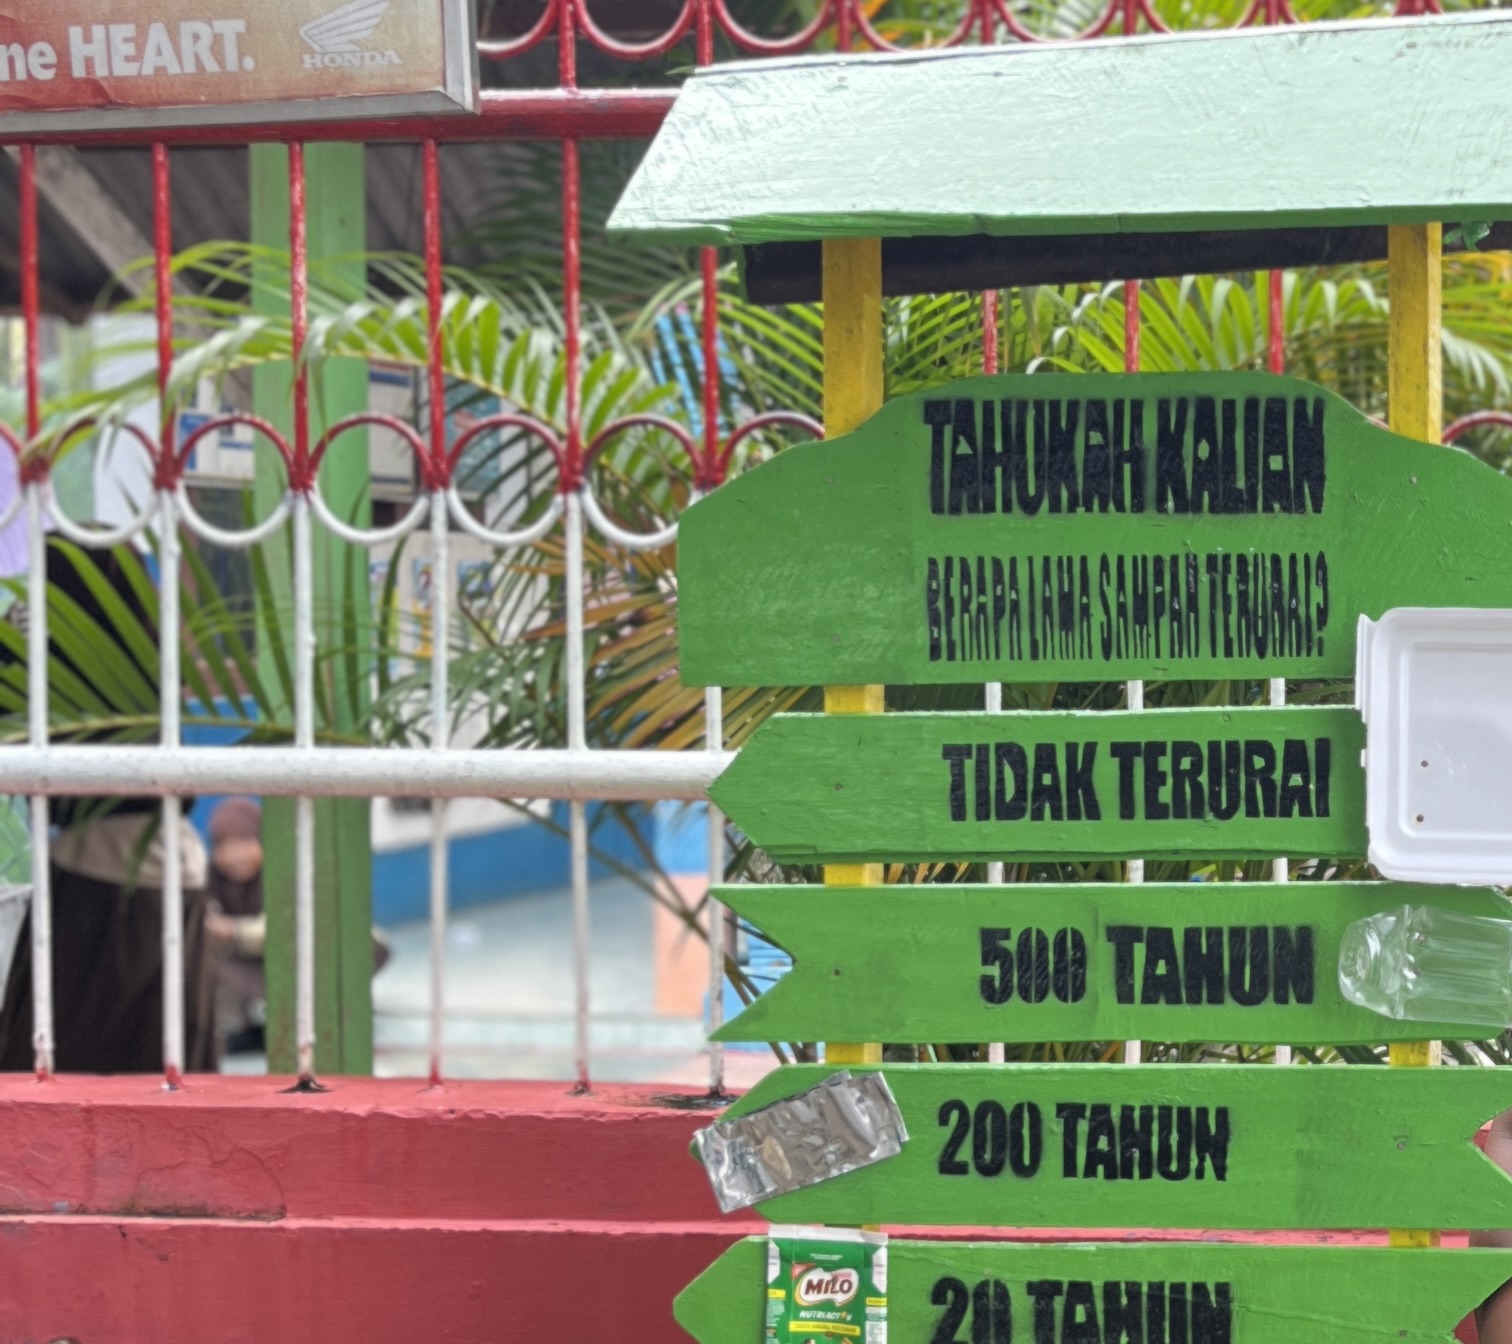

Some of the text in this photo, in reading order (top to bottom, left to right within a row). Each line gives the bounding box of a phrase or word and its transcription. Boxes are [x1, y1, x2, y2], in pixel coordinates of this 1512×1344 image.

[68, 18, 256, 79] HEART.
[302, 50, 403, 69] HONDA
[924, 397, 1326, 515] TAHUKAH KALIAN
[927, 551, 1329, 662] BERAPA LAMA SAMPAH TERURAI?
[942, 738, 1332, 822] TIDAK TERURAI
[979, 925, 1315, 1006] 500 TAHUN
[937, 1099, 1230, 1181] 200 TAHUN
[804, 1275, 853, 1296] MILO
